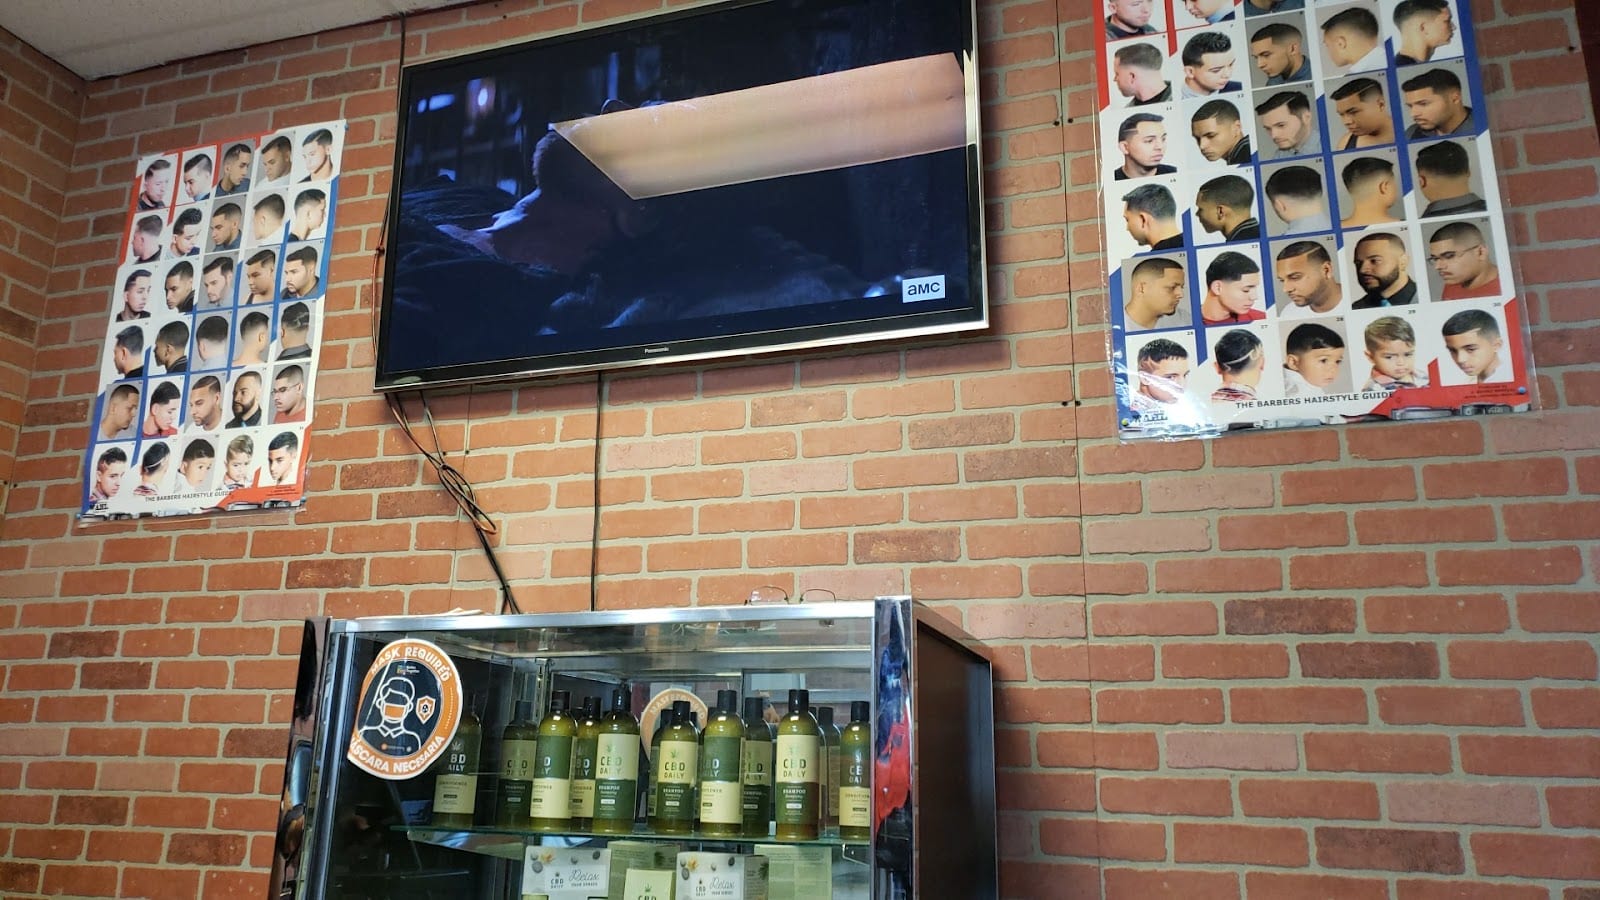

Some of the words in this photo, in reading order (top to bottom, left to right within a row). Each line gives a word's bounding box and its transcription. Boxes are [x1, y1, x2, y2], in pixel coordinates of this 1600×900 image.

[1236, 401, 1254, 409] THE
[1257, 398, 1301, 408] BARBERS
[1304, 393, 1359, 404] HAIRSTYLE
[370, 647, 400, 674] MASK
[404, 646, 451, 682] REQUIRED
[393, 735, 445, 773] NECESARIA
[450, 753, 466, 764] BD
[507, 759, 528, 769] CD
[664, 761, 686, 771] CBD
